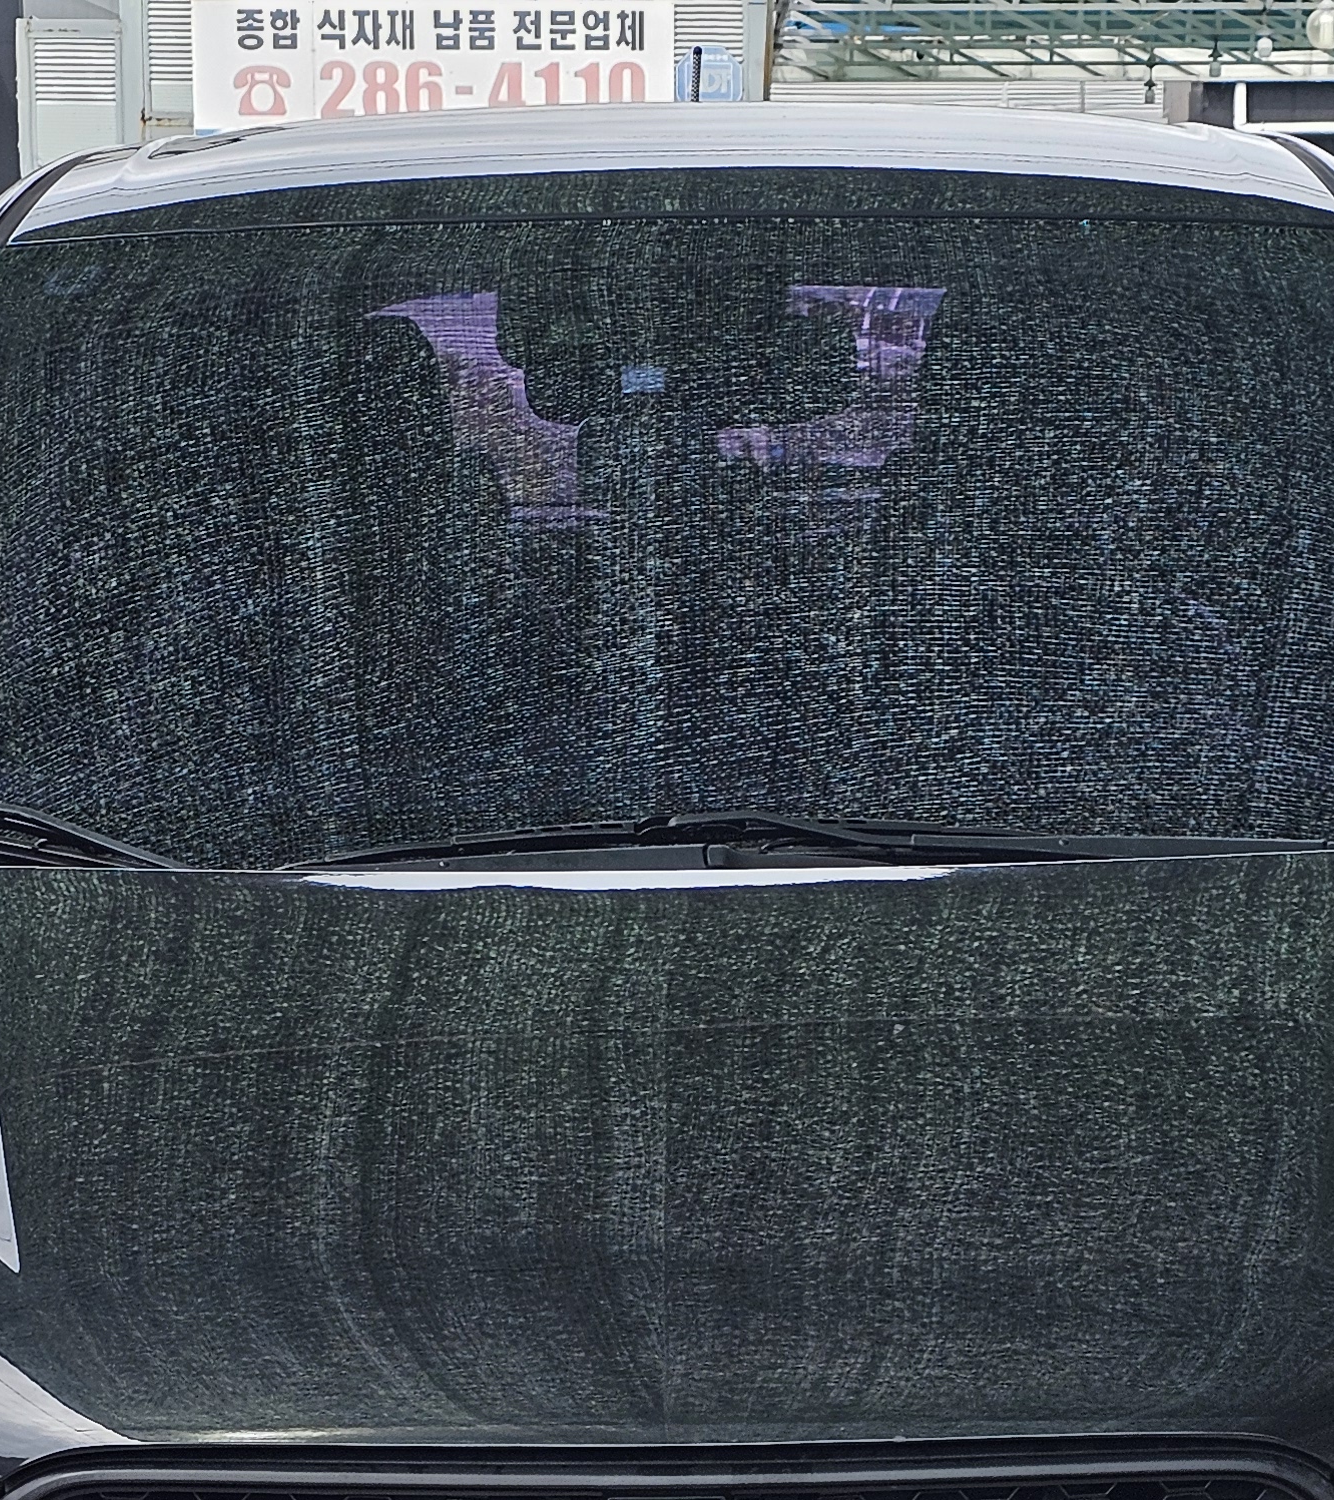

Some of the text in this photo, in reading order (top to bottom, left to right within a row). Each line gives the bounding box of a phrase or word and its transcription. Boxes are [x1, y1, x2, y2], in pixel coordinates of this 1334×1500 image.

[236, 8, 645, 51] 종합 식자재 납품 전문업체
[319, 60, 646, 119] 286-4110
